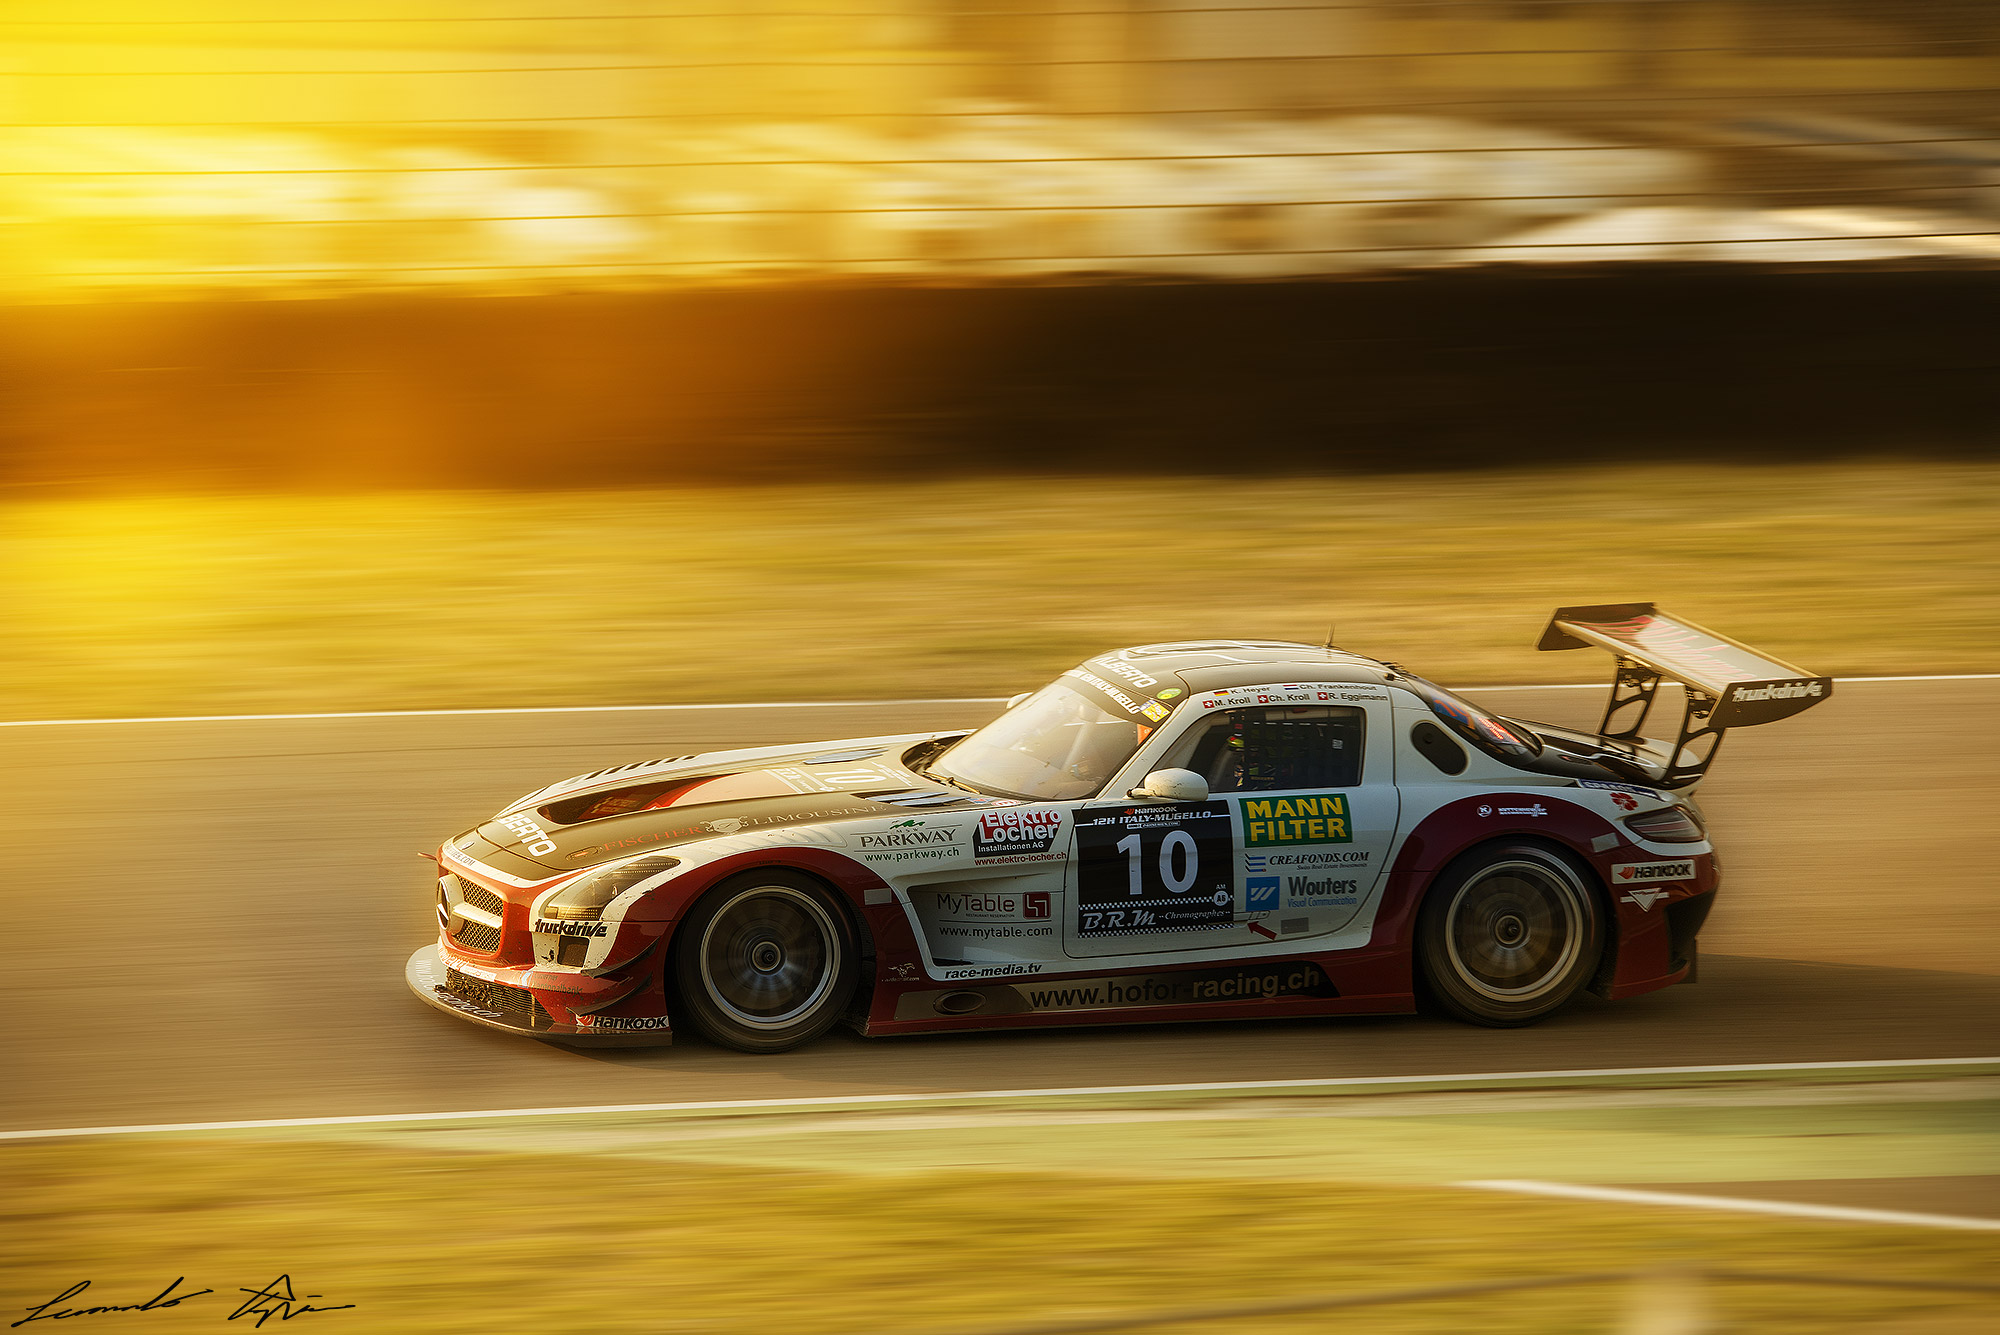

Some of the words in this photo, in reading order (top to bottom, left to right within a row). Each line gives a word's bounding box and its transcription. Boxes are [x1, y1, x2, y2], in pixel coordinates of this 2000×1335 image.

[1092, 656, 1158, 688] ALBERTO
[1341, 693, 1388, 701] Eggimann
[1731, 681, 1823, 702] truckdrive
[1214, 699, 1226, 707] M.
[1230, 697, 1251, 705] Kroll
[1246, 797, 1344, 819] MANN
[986, 809, 1063, 828] Elektro
[1093, 818, 1116, 826] 12H
[1119, 811, 1212, 824] ITALY-MUGELLO
[604, 825, 702, 851] FISCHER
[860, 829, 957, 848] PARKWAY
[978, 821, 1060, 844] Locher
[1250, 817, 1347, 842] FILTER
[864, 847, 960, 863] www.parkway.ch
[978, 844, 1031, 852] Installationen
[974, 851, 1067, 866] www.elektro-locher.ch
[1116, 830, 1199, 896] 10
[1269, 851, 1370, 866] CREAFONDS.COM
[1287, 875, 1357, 897] Wouters
[937, 893, 1015, 914] MyTable
[1287, 899, 1307, 908] Visual
[1308, 896, 1357, 906] Communication
[534, 919, 607, 937] truckdrive
[1082, 909, 1157, 930] B.R.M
[939, 926, 1053, 940] www.mytable.com
[945, 963, 1042, 979] race-media.tv
[1031, 966, 1320, 1008] www.hofor-racing.ch
